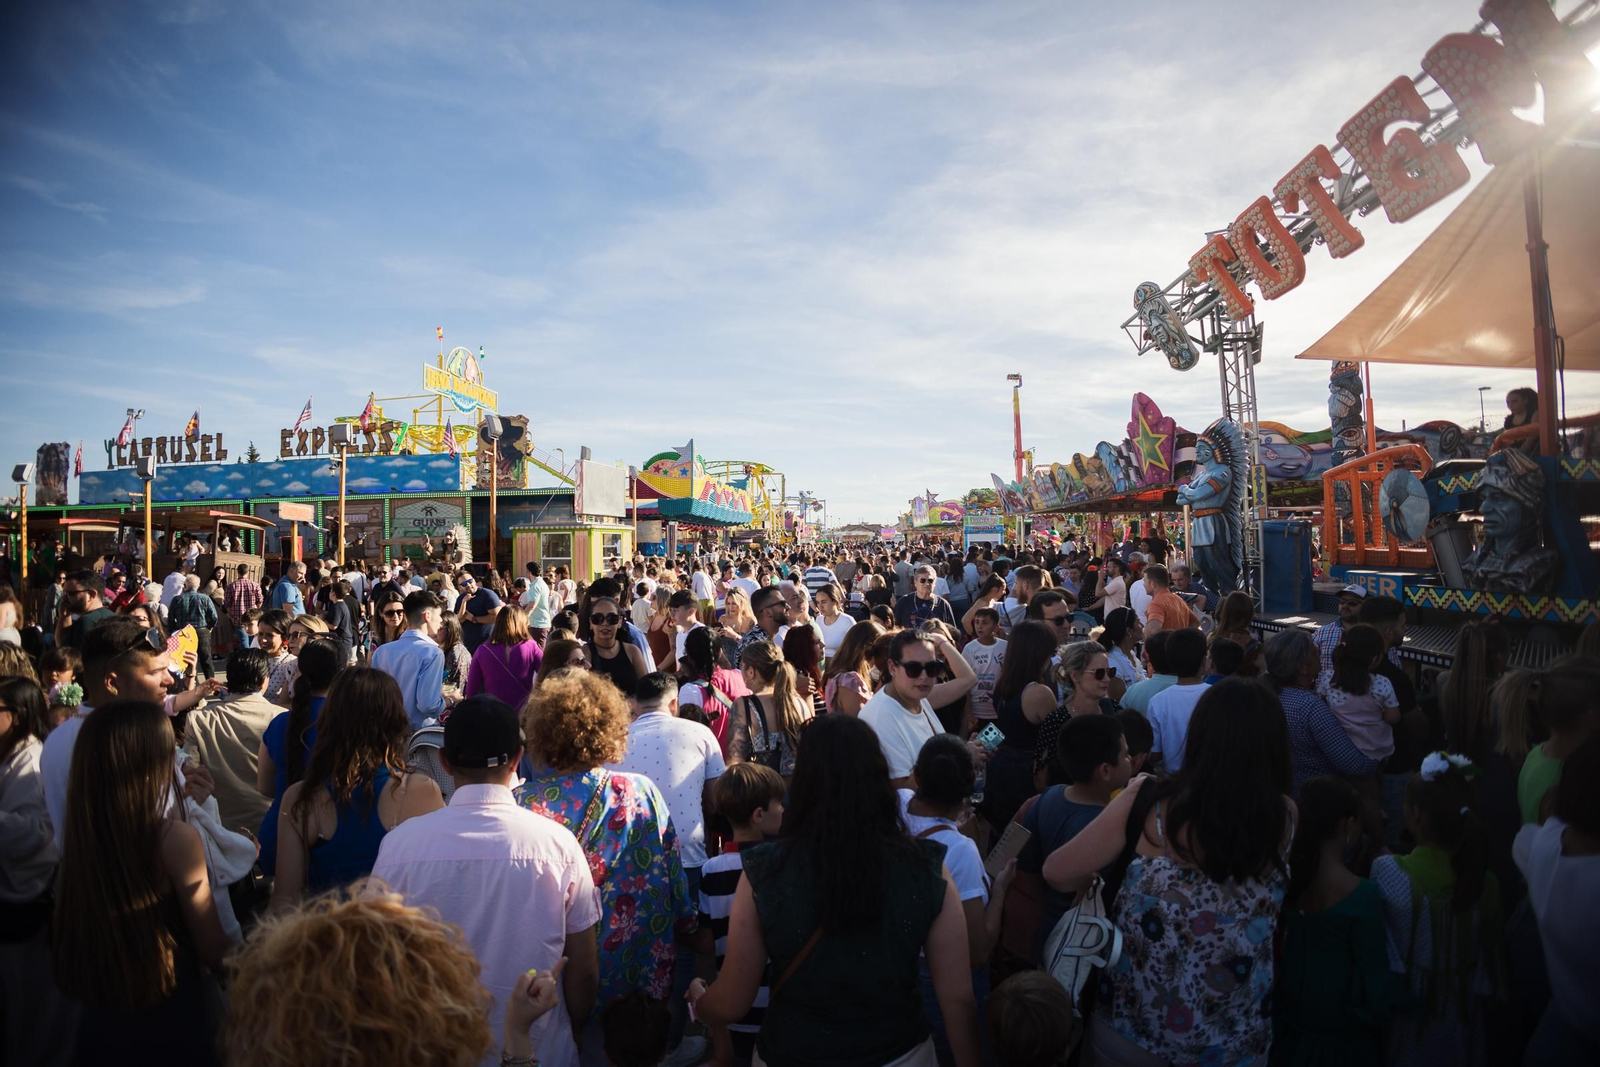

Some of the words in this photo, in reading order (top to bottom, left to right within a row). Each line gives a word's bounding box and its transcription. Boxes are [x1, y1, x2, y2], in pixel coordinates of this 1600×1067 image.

[116, 433, 228, 466] CARRUSEL
[1253, 466, 1266, 506] SALIDA
[412, 518, 447, 528] GUNS
[1347, 574, 1397, 600] SUPER
